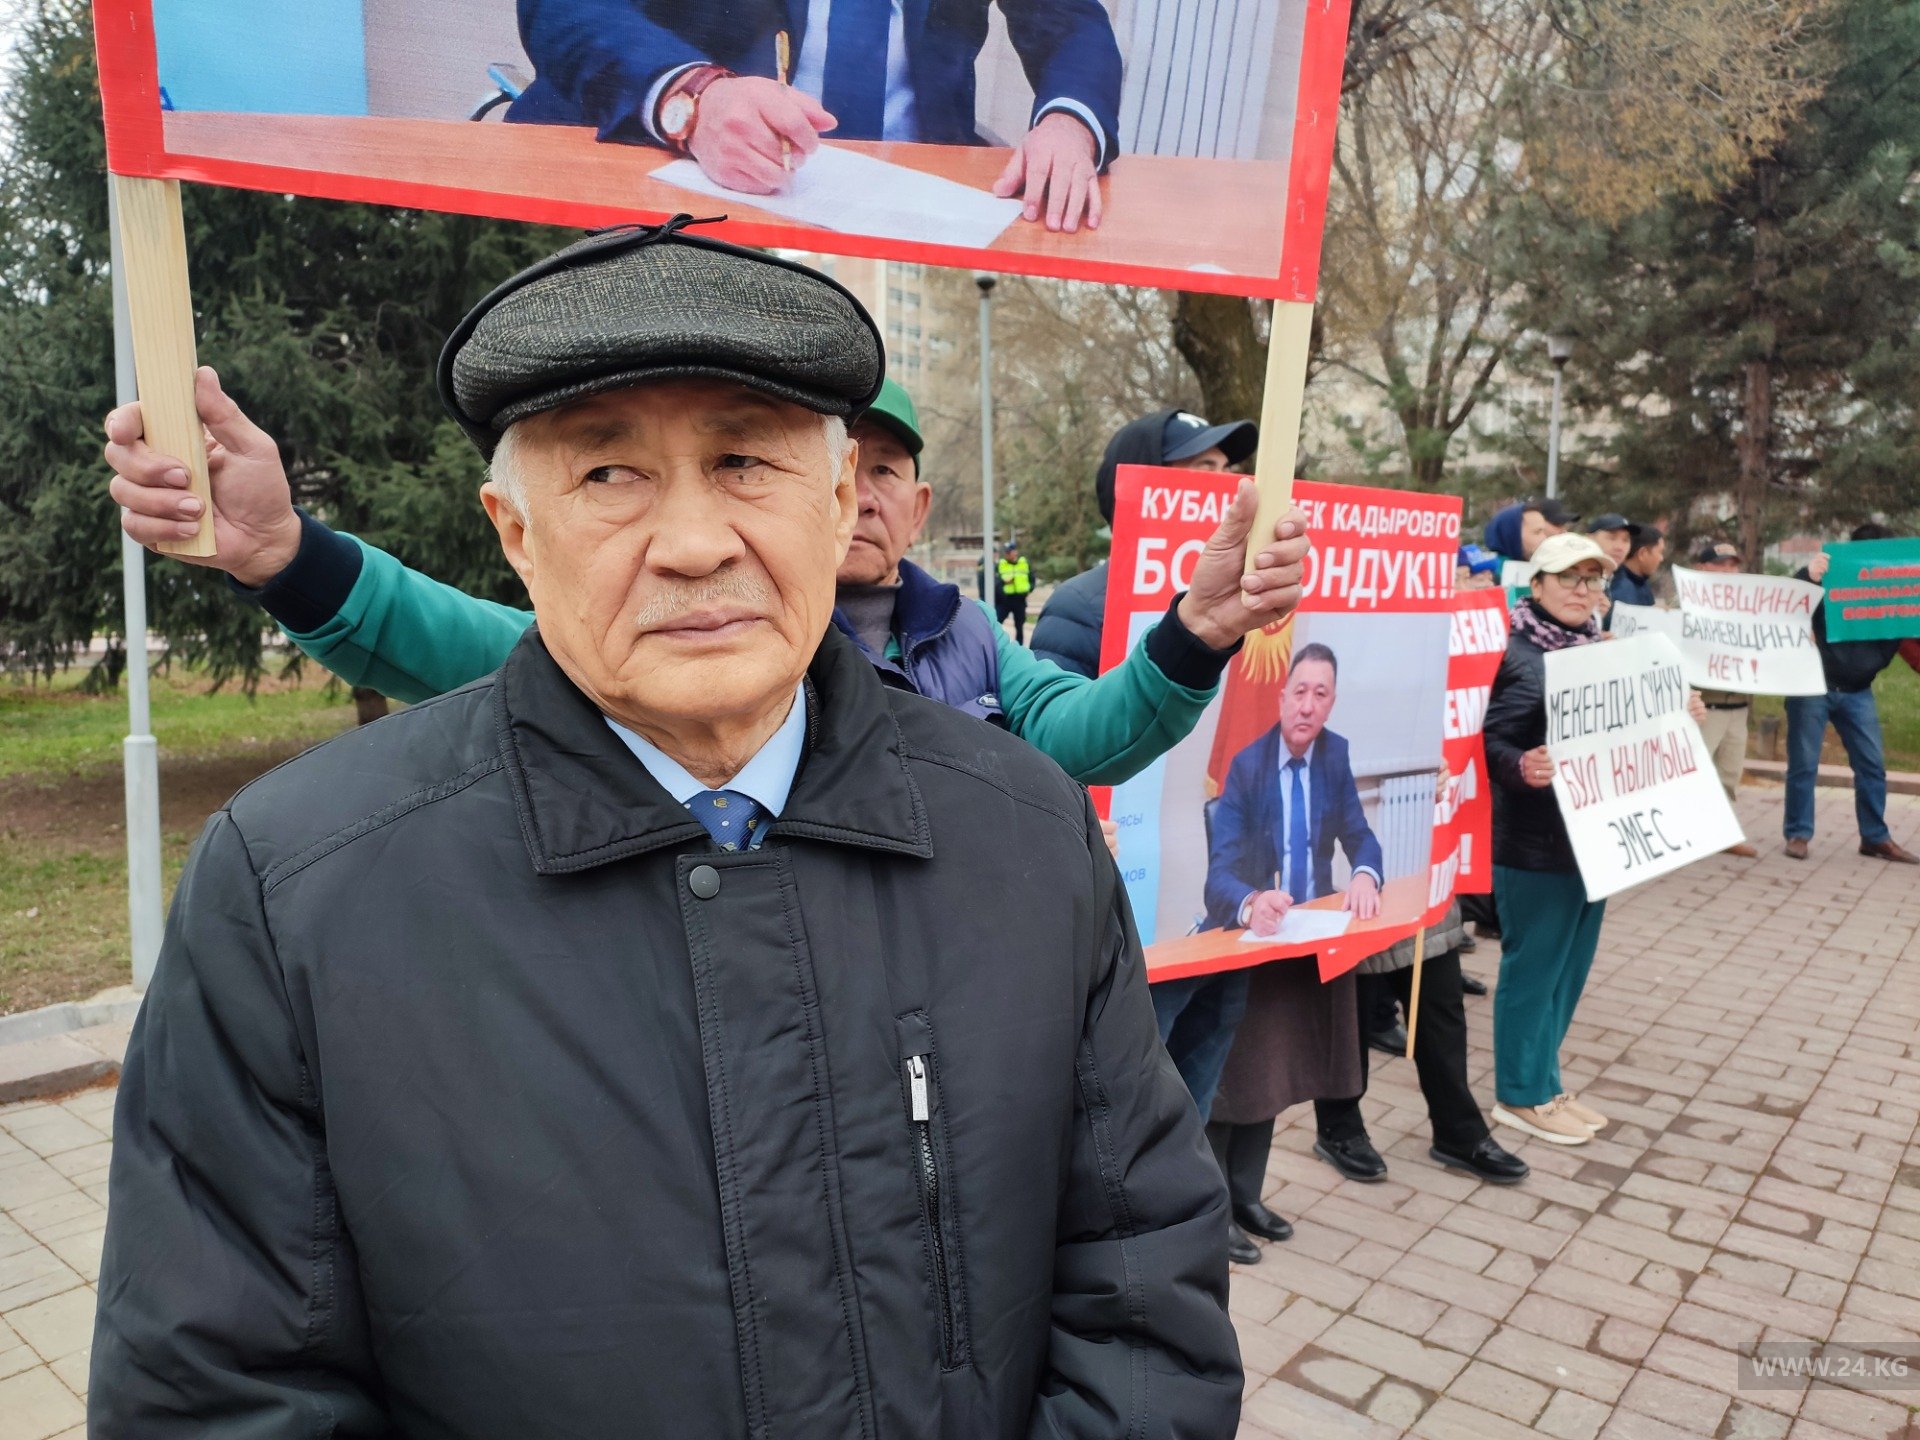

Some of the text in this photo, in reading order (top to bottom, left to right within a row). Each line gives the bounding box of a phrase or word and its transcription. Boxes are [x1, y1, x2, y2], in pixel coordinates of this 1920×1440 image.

[1332, 502, 1461, 538] КАДЫРОВГО
[1681, 580, 1810, 615] АКАЕВЩИНА
[1550, 676, 1637, 745] МЕКЕНДИ
[1559, 727, 1697, 810] БУЛ КЫЛМЫШ
